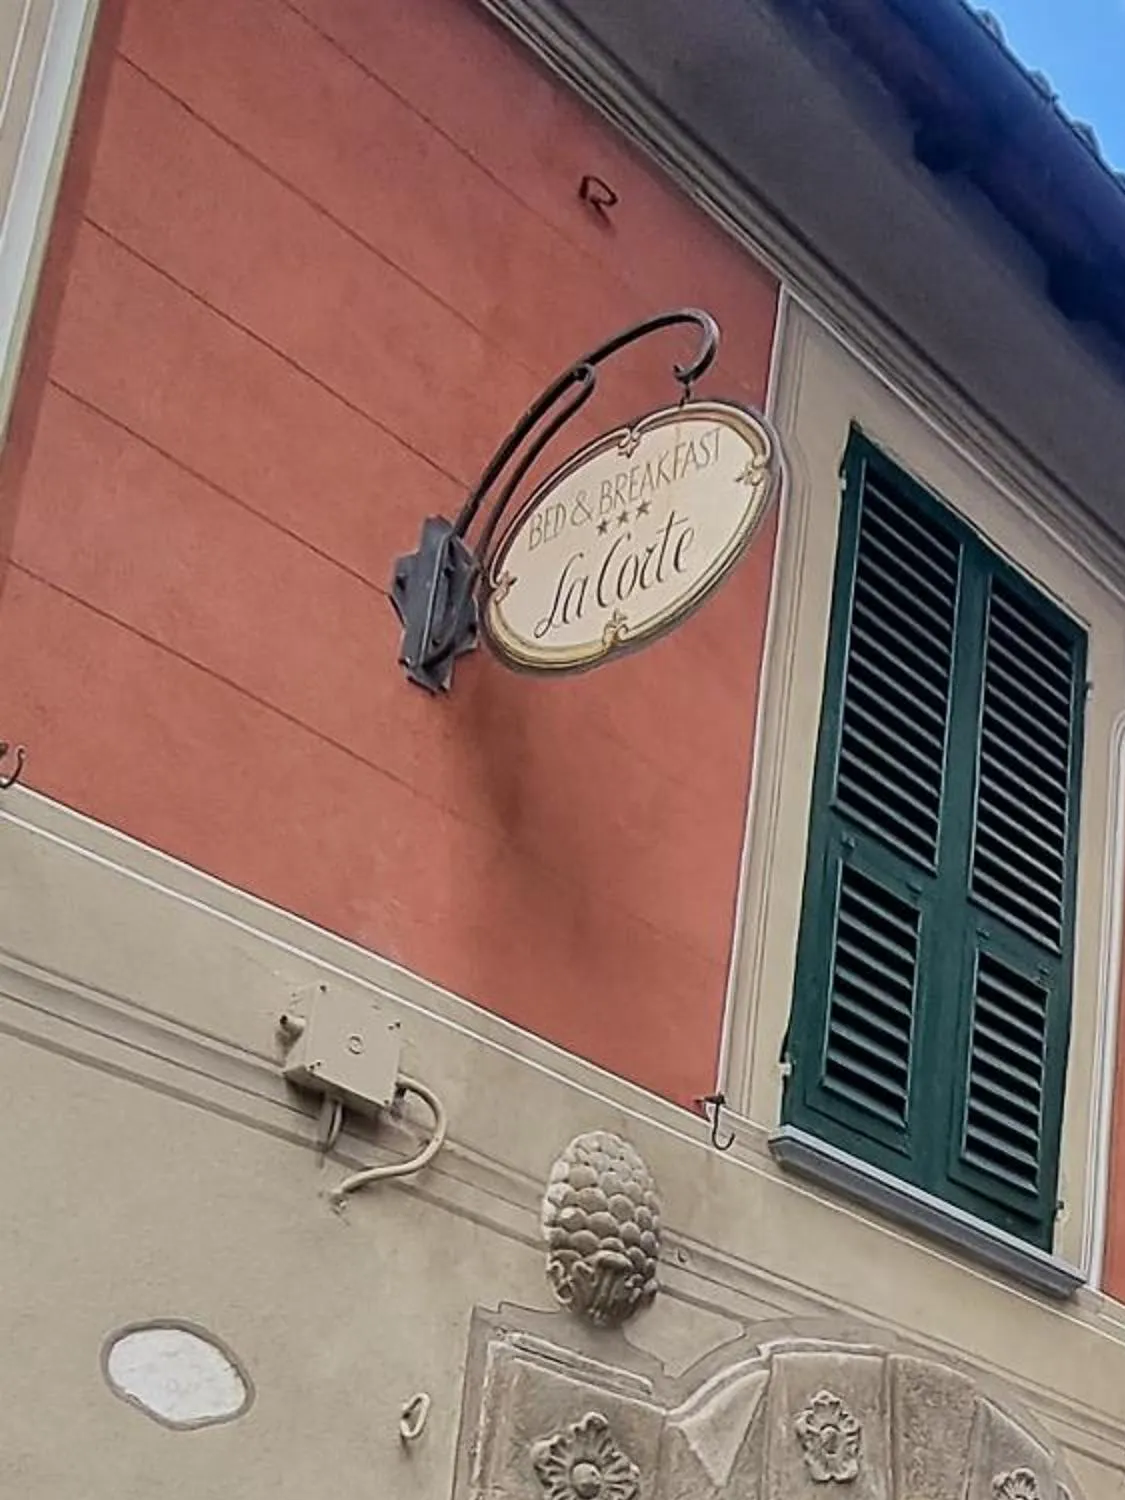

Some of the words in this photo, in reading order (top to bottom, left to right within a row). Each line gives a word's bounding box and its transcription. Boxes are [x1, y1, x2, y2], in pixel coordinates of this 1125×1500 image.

[528, 507, 568, 551] BED
[570, 491, 594, 526] &
[600, 427, 722, 514] BREAKFAST
[534, 552, 590, 639] La
[597, 510, 695, 609] Corte
